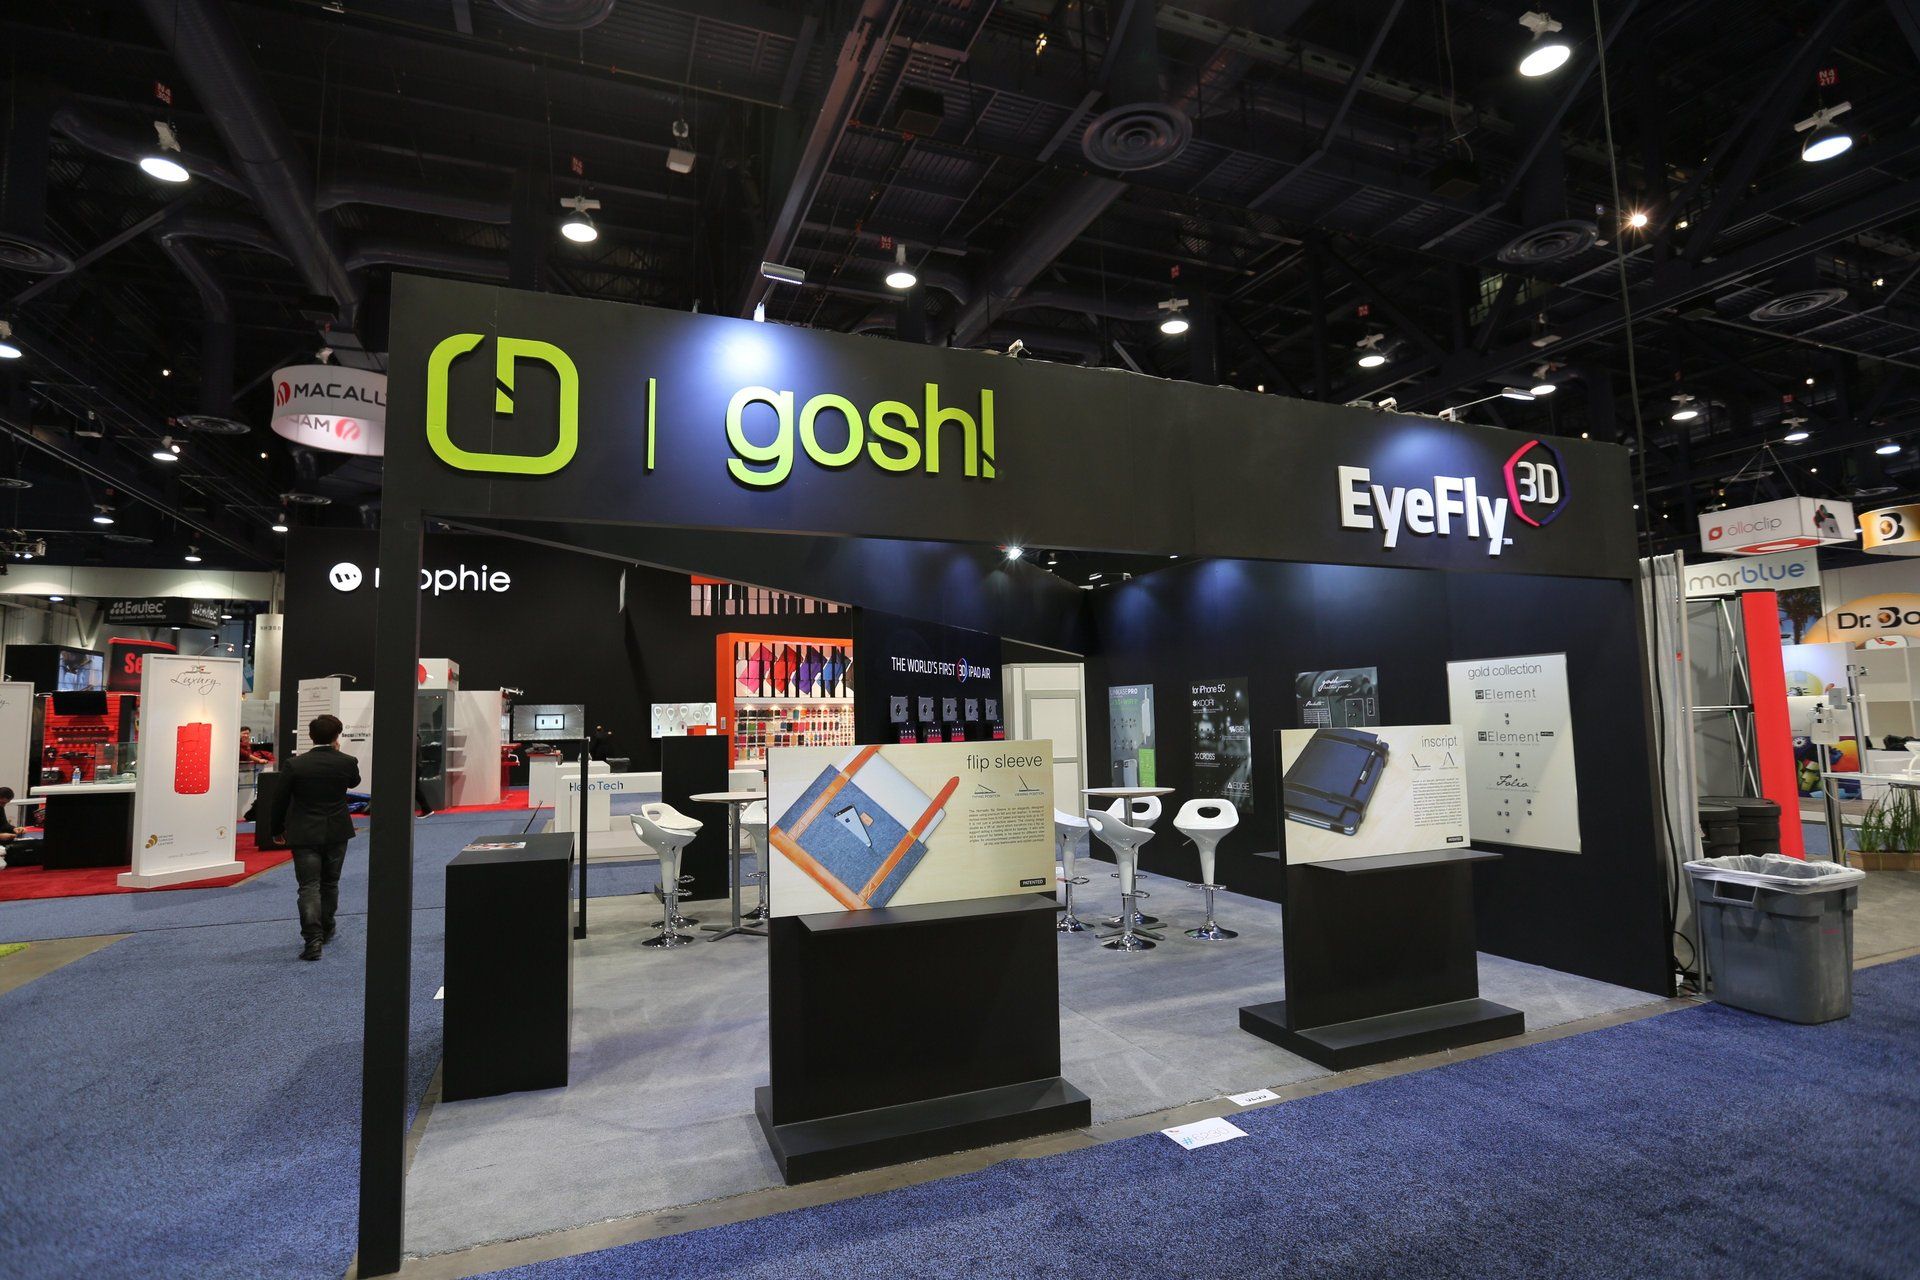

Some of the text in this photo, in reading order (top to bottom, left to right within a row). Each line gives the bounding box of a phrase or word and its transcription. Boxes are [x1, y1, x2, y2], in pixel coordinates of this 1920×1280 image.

[294, 383, 387, 407] MACALL
[726, 382, 996, 486] gosh!
[1338, 461, 1559, 556] EyeFly 3D
[375, 563, 511, 597] ophie
[1689, 562, 1805, 591] marblue
[1837, 612, 1871, 629] Dr.
[891, 656, 906, 671] THE
[907, 658, 938, 674] WORLD'S
[938, 662, 956, 676] FIRST
[981, 667, 991, 679] AIR
[1468, 663, 1542, 680] gold collection
[170, 672, 221, 695] Luxury
[1200, 685, 1217, 693] iPhone
[1484, 688, 1536, 700] Element
[1421, 735, 1457, 749] inscript
[1487, 731, 1540, 742] Element
[967, 754, 1043, 772] flip sleeve
[1199, 752, 1216, 760] CROSS
[569, 780, 624, 791] Heo Tech
